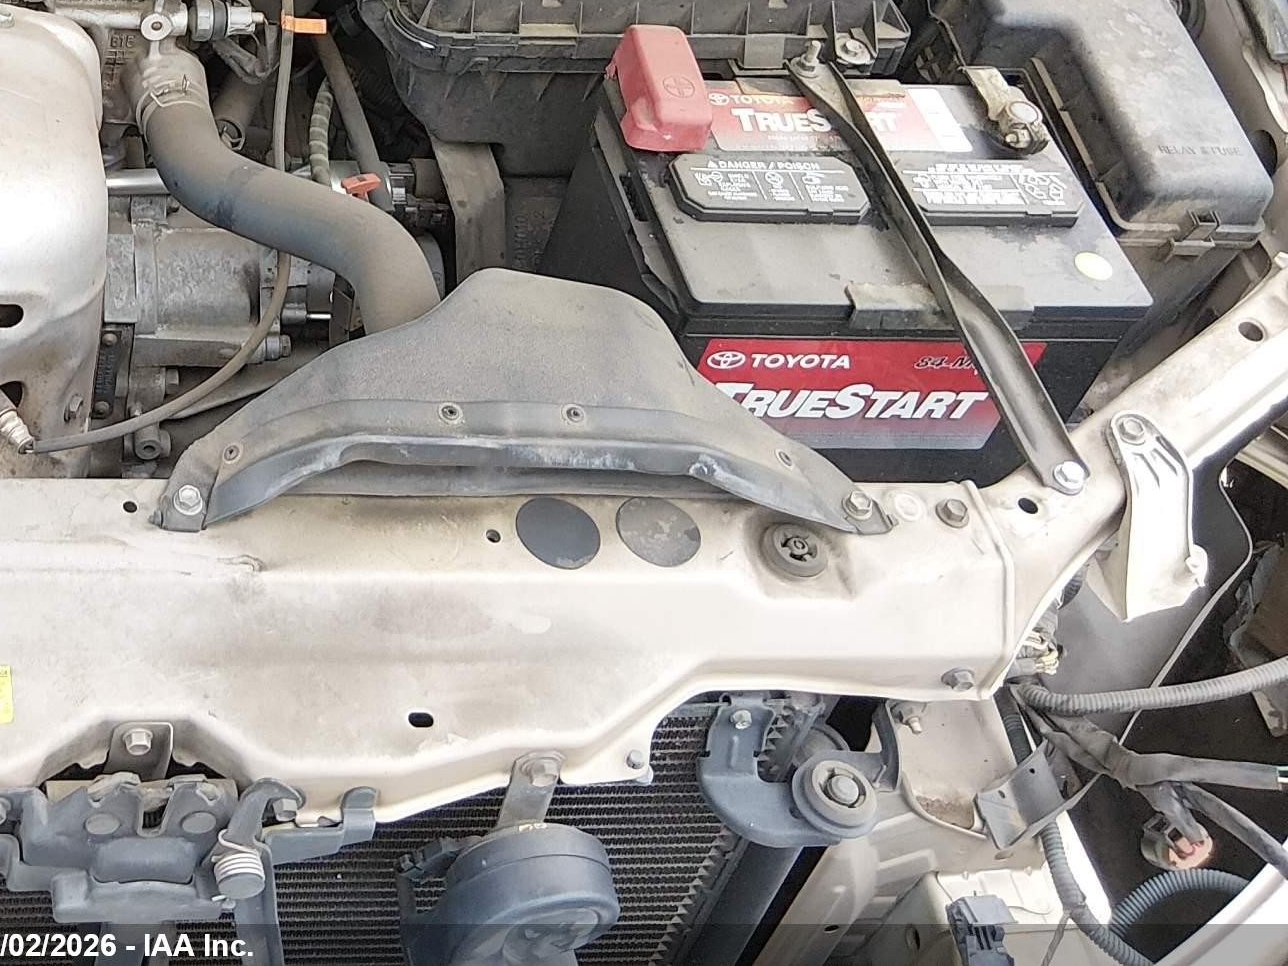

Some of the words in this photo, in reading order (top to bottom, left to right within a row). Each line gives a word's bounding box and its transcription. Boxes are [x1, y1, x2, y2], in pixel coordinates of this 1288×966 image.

[730, 93, 795, 106] TOYOTA
[731, 107, 898, 133] TRUESRT
[718, 160, 767, 171] DANGER
[777, 161, 821, 171] POISON
[751, 353, 851, 370] TOYOTA
